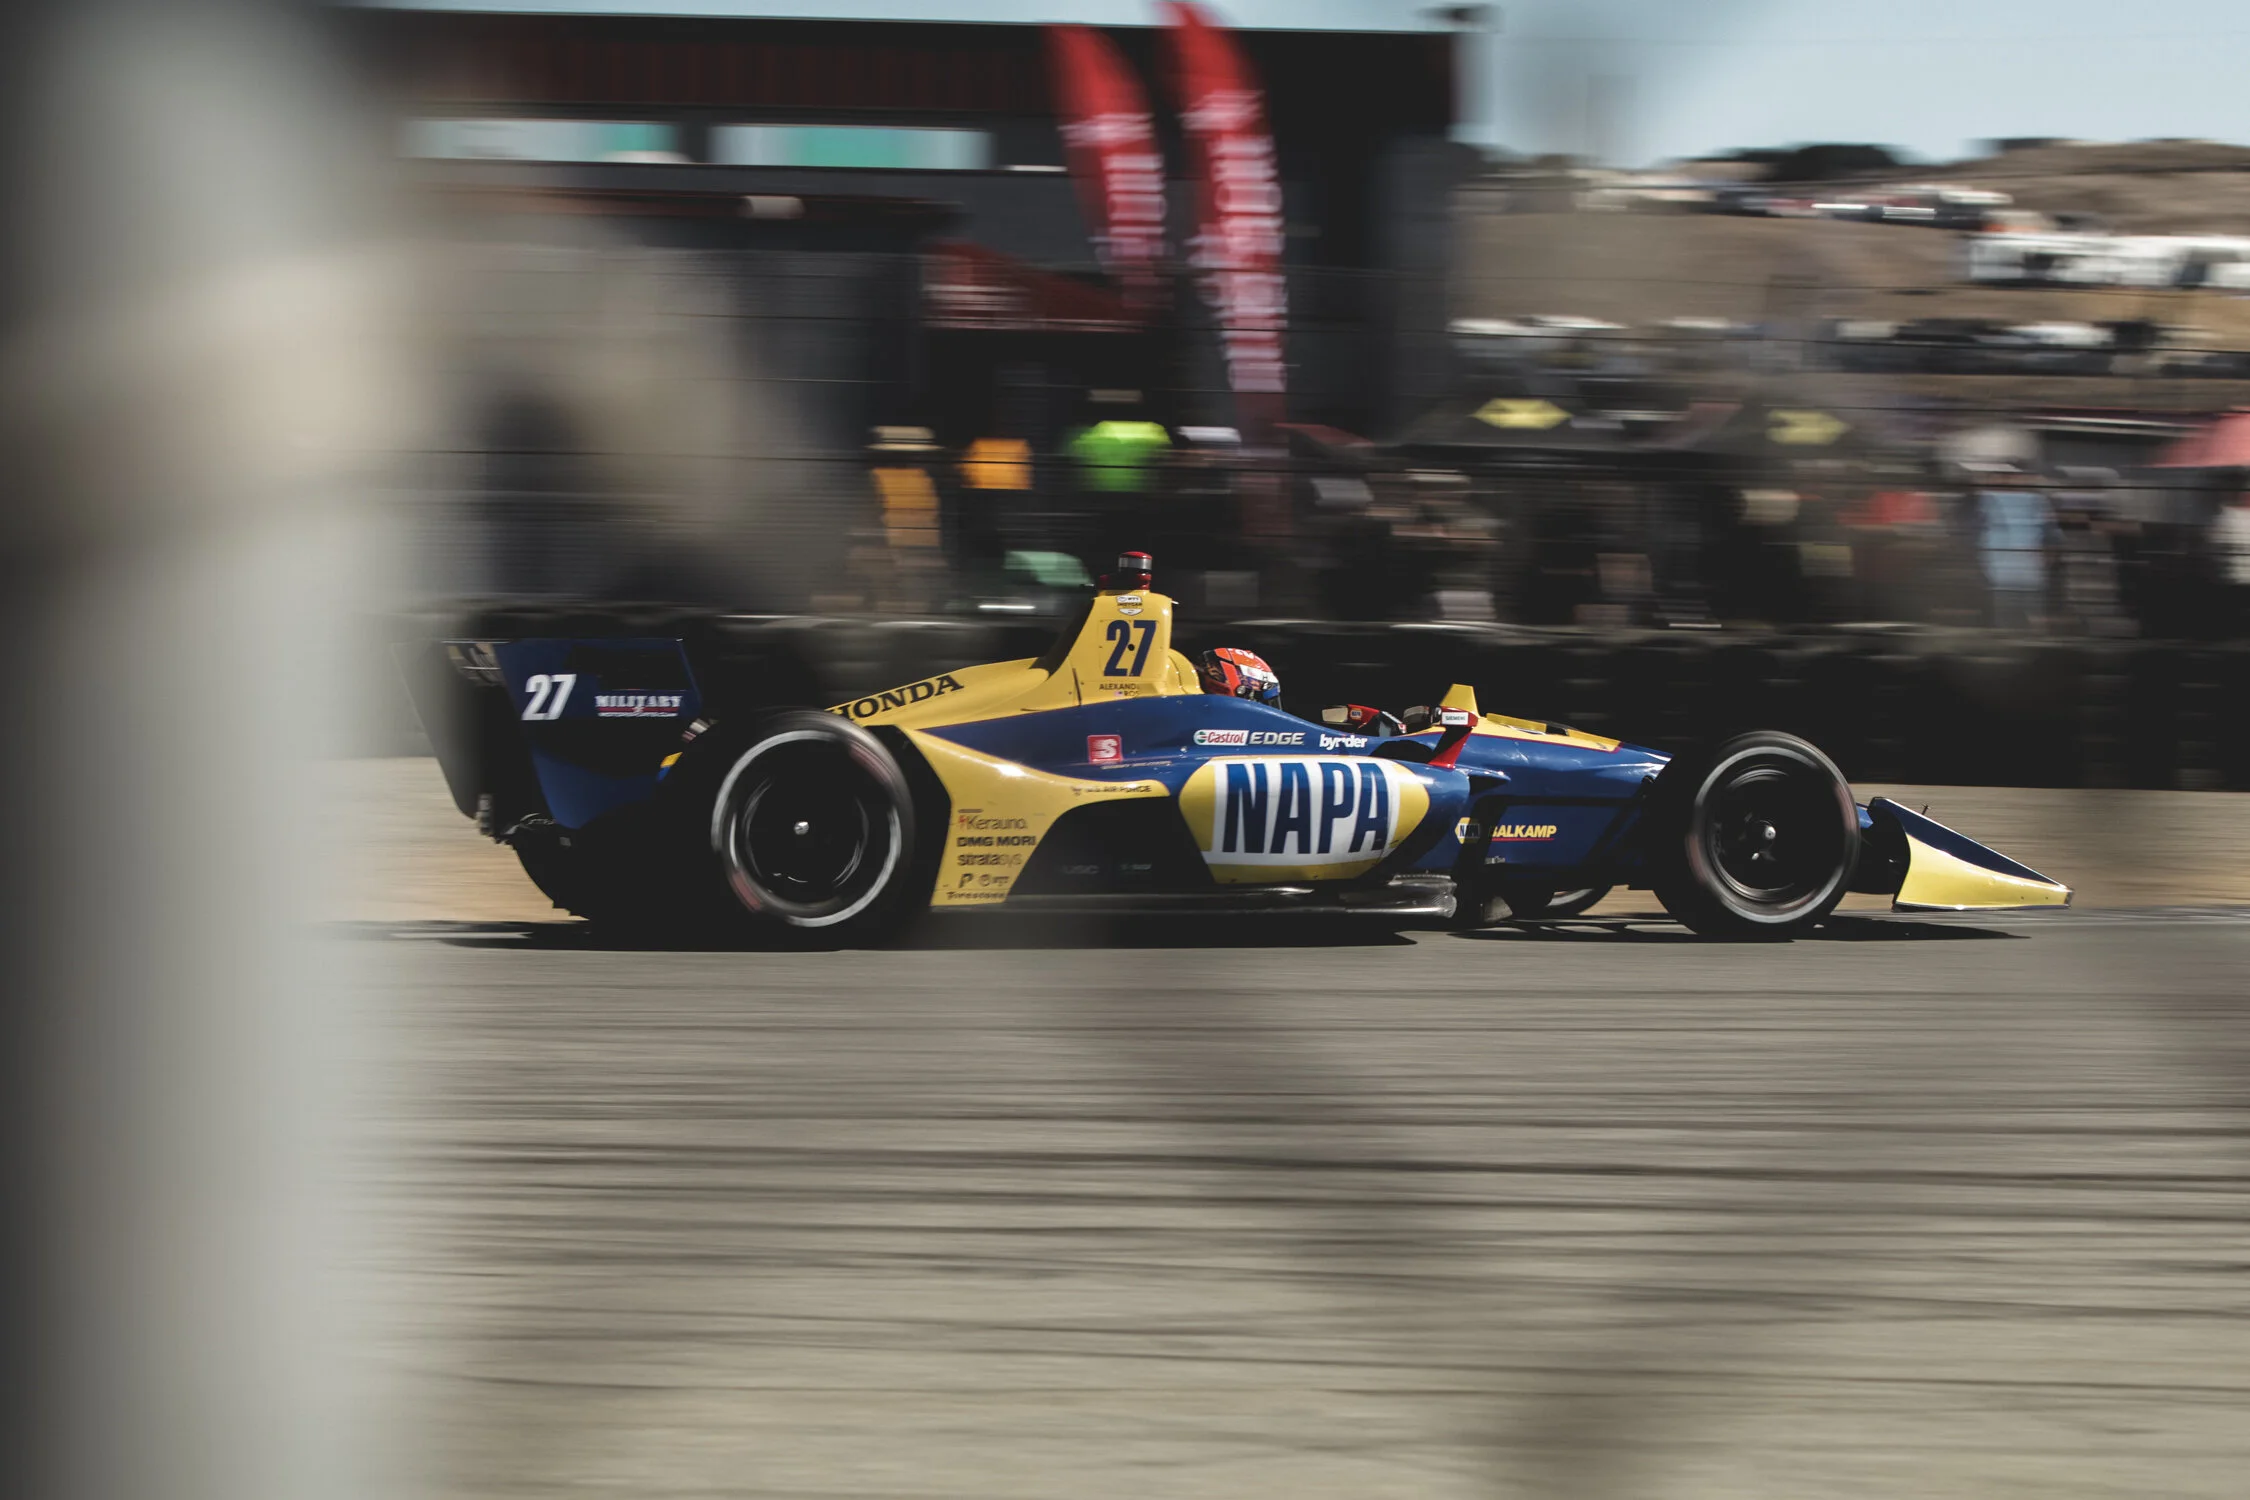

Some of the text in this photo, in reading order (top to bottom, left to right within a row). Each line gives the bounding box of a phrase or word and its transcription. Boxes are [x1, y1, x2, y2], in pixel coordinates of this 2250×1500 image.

[1104, 619, 1157, 677] 27
[521, 673, 577, 721] 27
[594, 695, 682, 707] MILITARY
[1208, 731, 1306, 746] Castrol EDGE
[1222, 762, 1390, 855] NAPA
[957, 835, 1036, 847] DMG MORI
